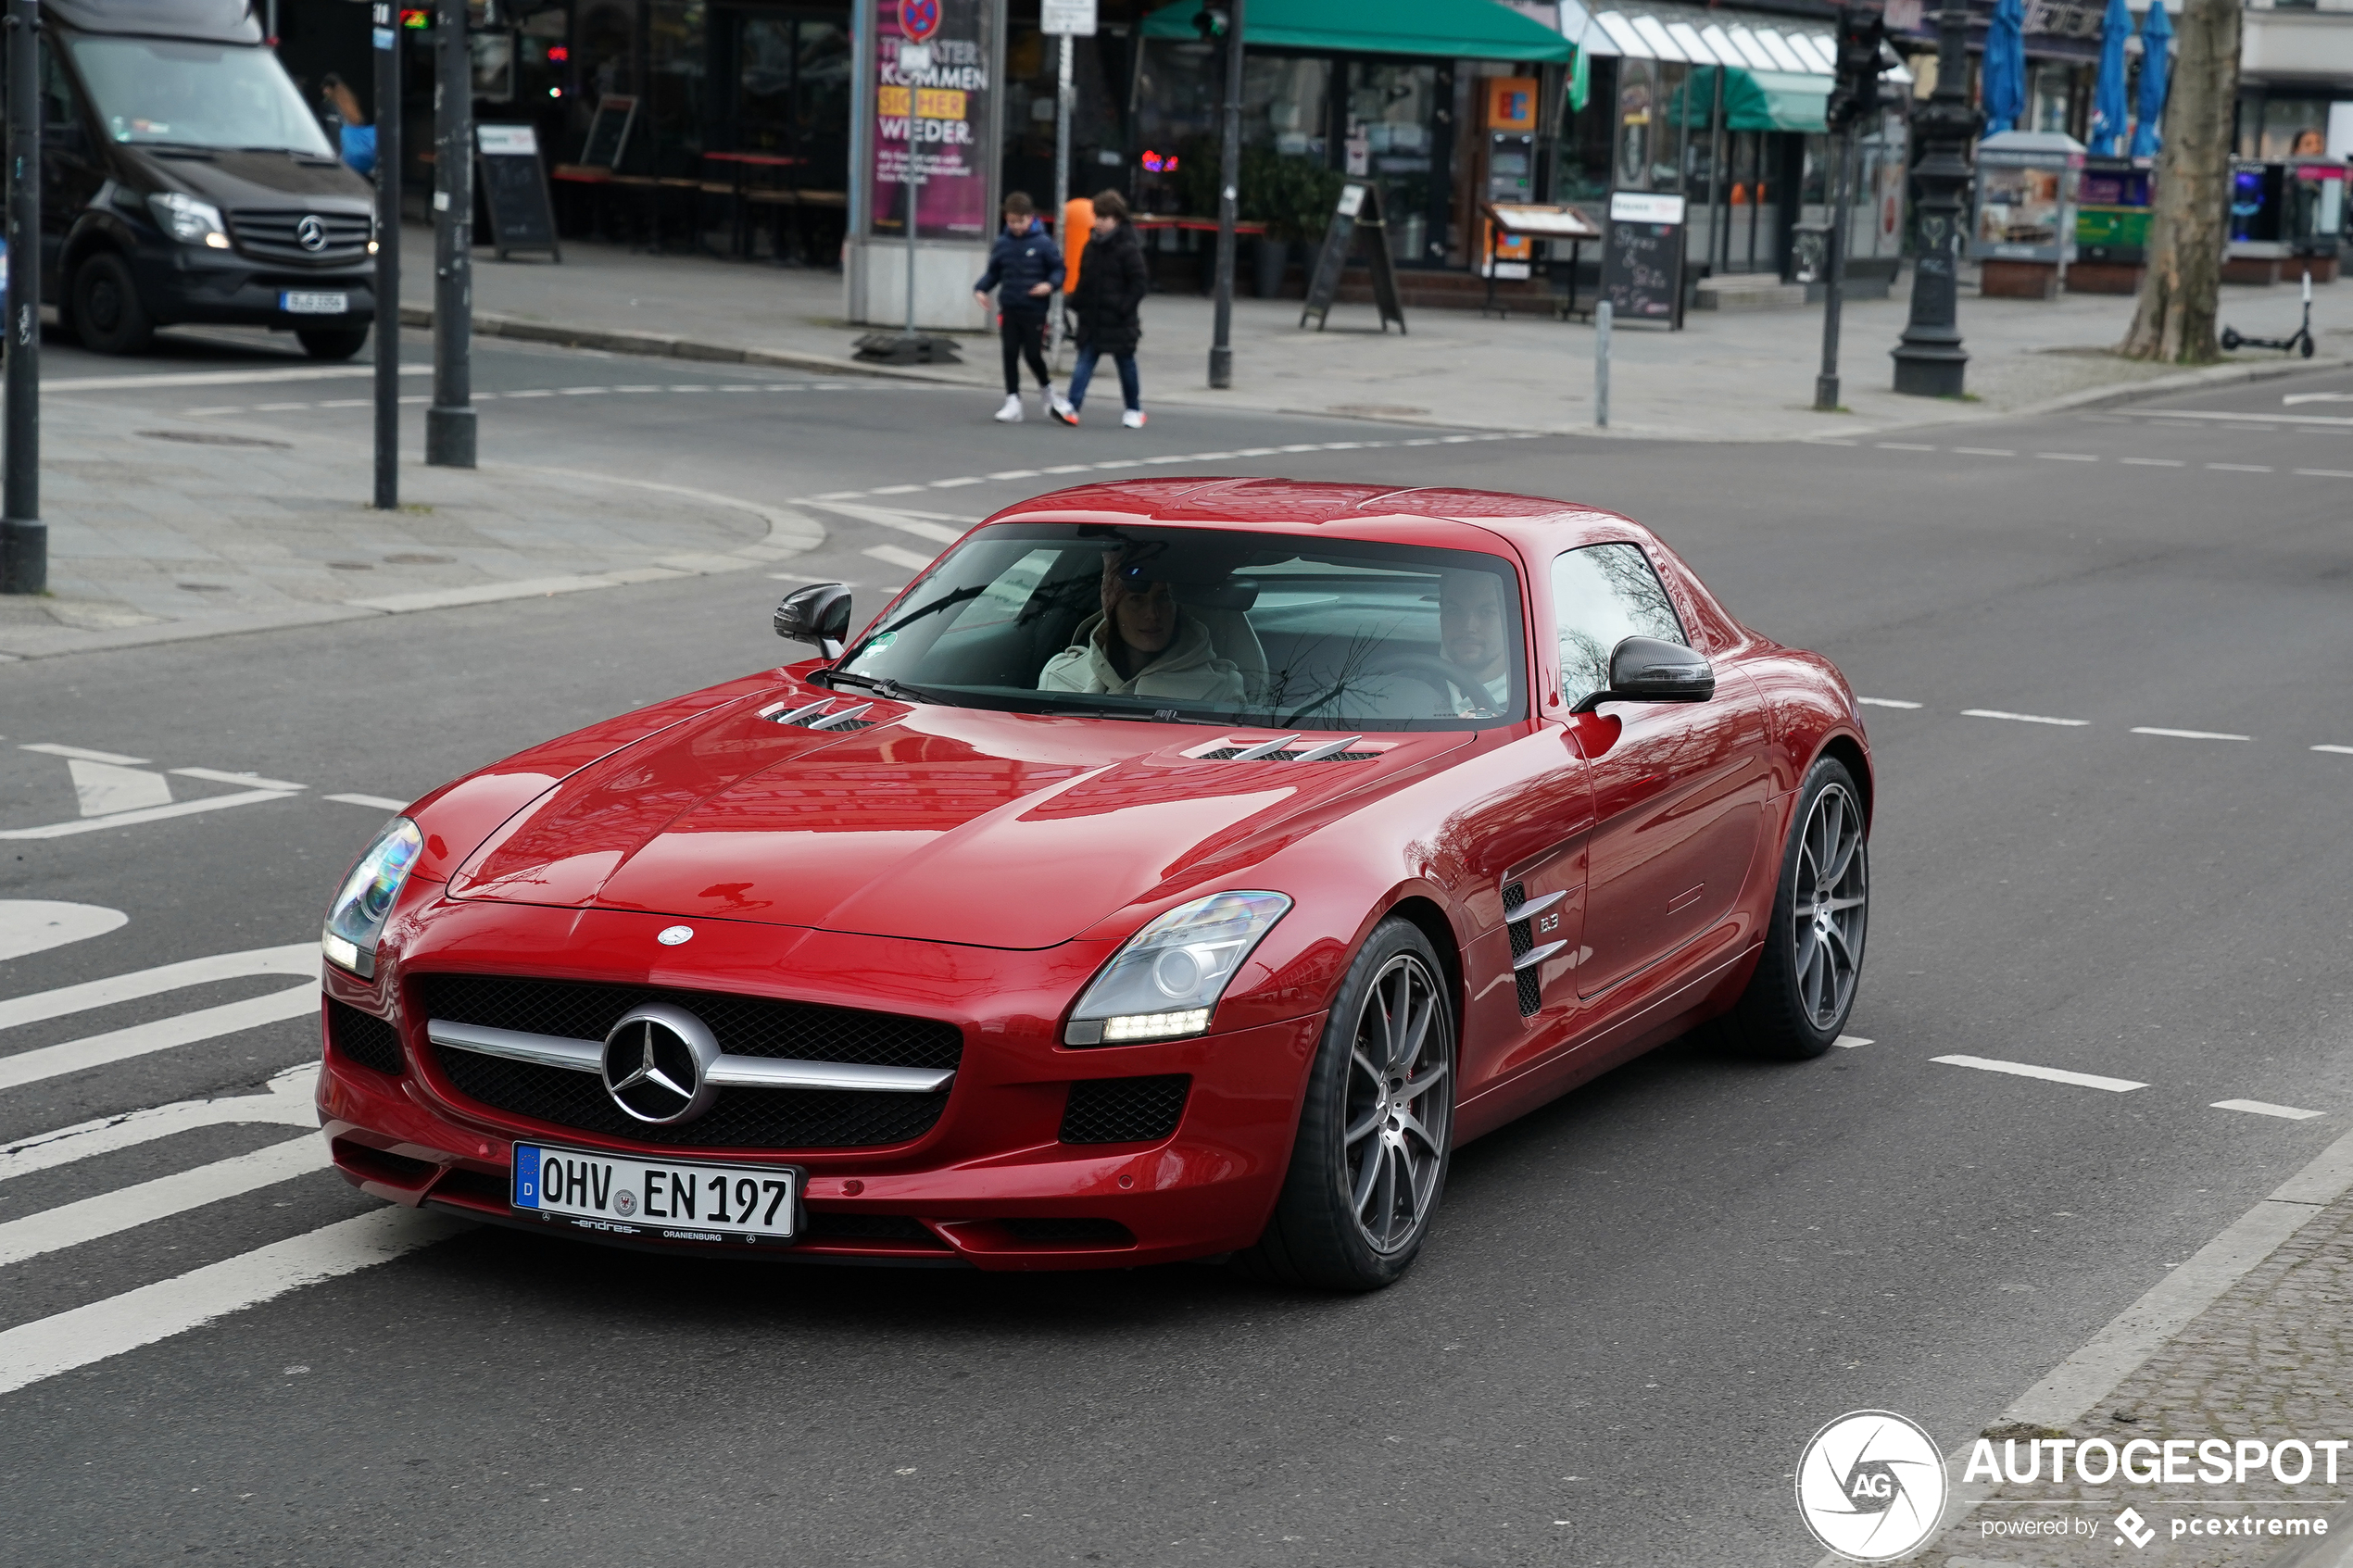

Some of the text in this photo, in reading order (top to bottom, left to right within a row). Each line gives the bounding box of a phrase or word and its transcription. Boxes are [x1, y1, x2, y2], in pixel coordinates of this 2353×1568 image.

[880, 61, 989, 90] KOMMEN
[524, 1183, 533, 1196] D
[542, 1156, 612, 1210] OHV
[644, 1170, 697, 1220] EN
[707, 1175, 787, 1226] 197
[662, 1230, 723, 1242] ORANIENBURG
